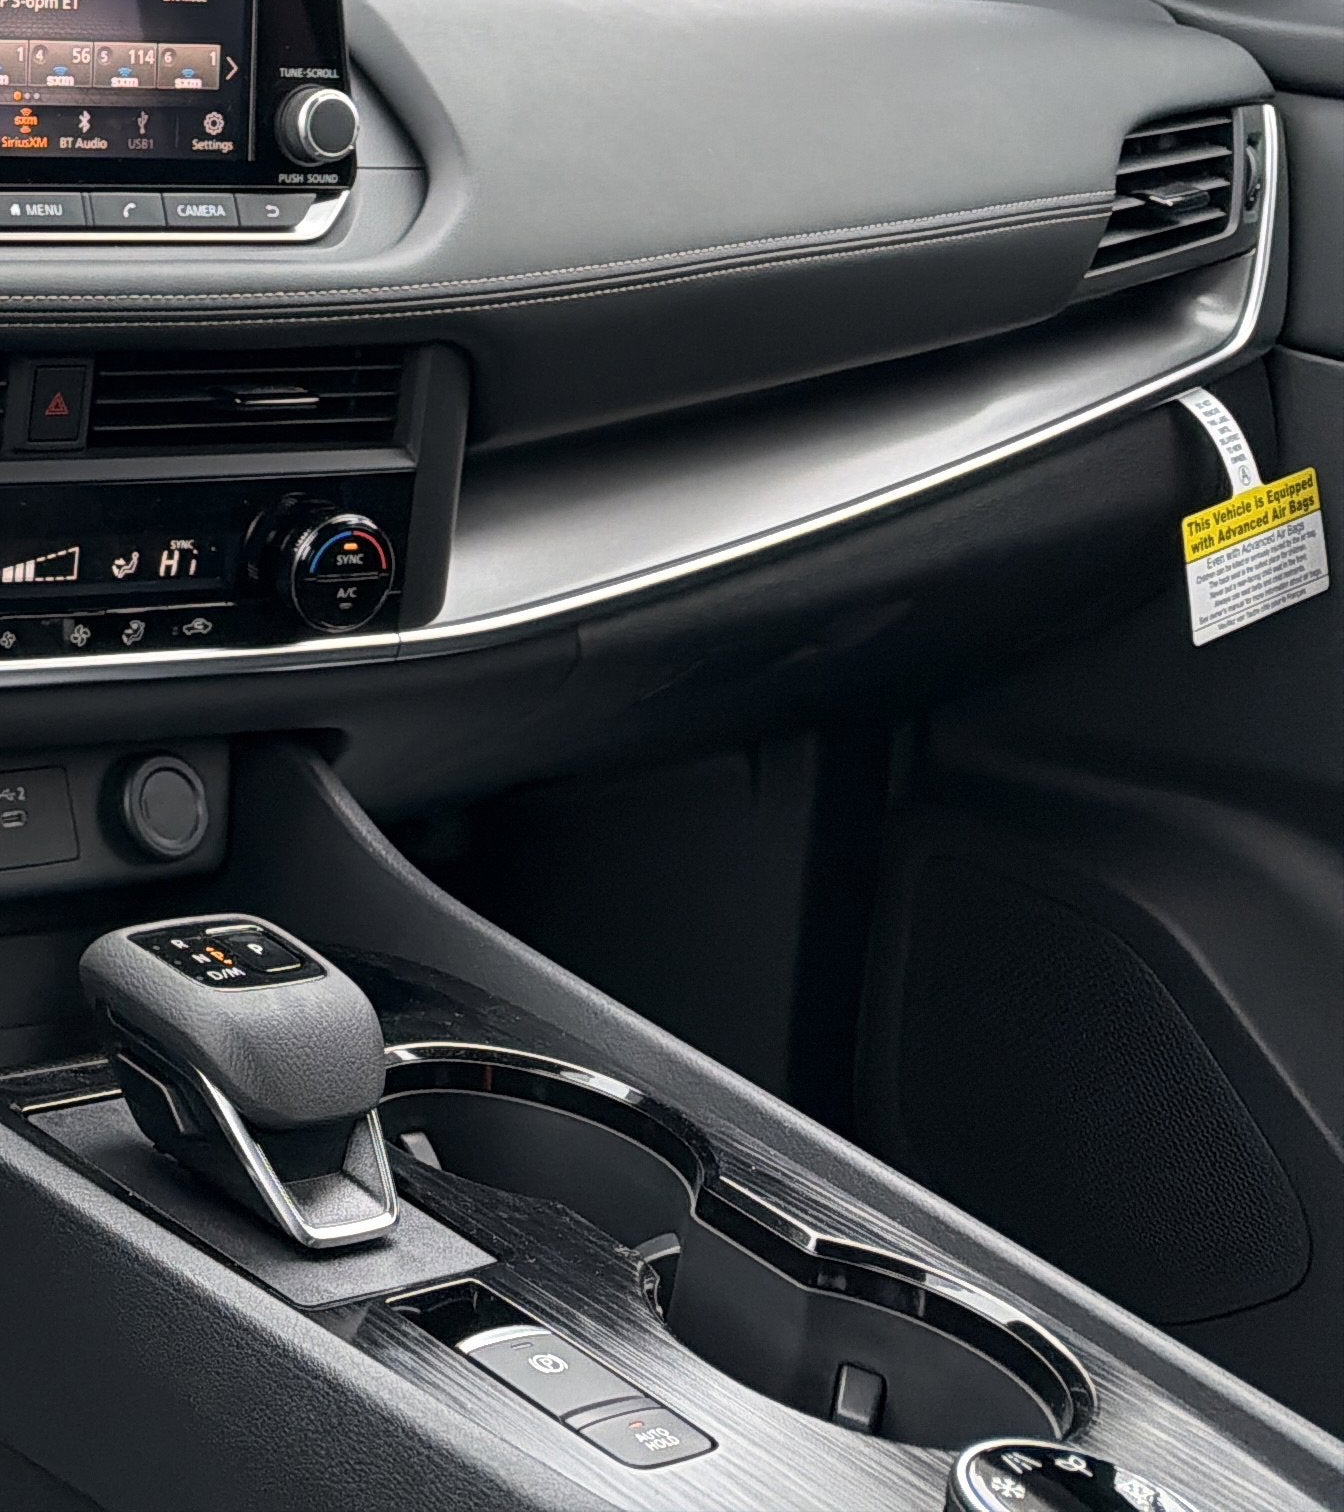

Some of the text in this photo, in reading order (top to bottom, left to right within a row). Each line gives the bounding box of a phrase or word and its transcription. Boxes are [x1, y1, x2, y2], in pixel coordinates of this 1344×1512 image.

[17, 46, 24, 62] 1
[72, 48, 91, 64] 56
[128, 49, 155, 65] 114
[209, 51, 217, 66] 1
[1, 136, 48, 148] SiriusXM
[59, 137, 108, 149] BT Audio
[128, 139, 154, 150] USB1
[192, 138, 234, 153] Settings
[278, 173, 339, 184] PUSH SOUND
[26, 203, 63, 218] MENU
[176, 203, 226, 218] CAMERA
[1187, 473, 1314, 537] This Vehicle is Equipped
[1191, 495, 1315, 555] with Advanced Air Bags
[170, 539, 195, 550] SYNC
[159, 549, 199, 577] Hi
[336, 553, 364, 566] SYNC
[336, 587, 358, 598] A/C
[16, 787, 26, 801] 2
[247, 943, 264, 955] P
[206, 967, 246, 981] D/M
[635, 1427, 670, 1442] AUTO
[644, 1436, 680, 1452] HOLD
